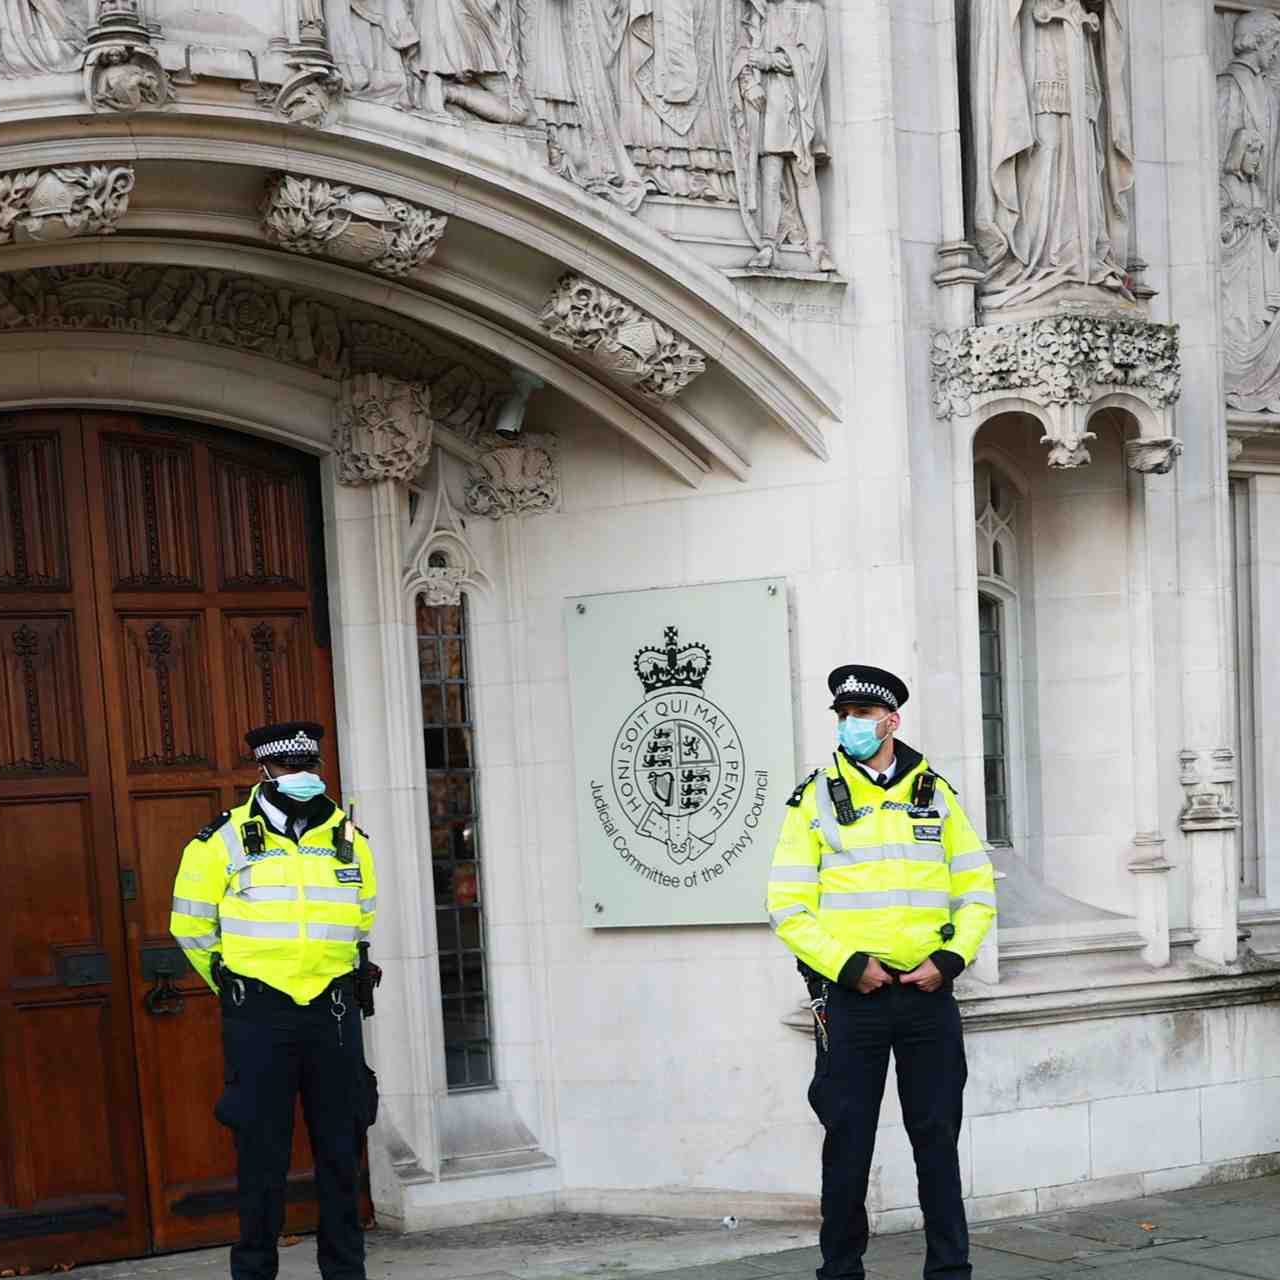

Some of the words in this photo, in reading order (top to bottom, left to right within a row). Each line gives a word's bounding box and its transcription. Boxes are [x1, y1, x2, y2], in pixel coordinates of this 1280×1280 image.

[655, 700, 688, 717] QUI
[694, 704, 725, 738] MAL
[621, 711, 649, 752] SOIT
[723, 739, 737, 751] Y
[618, 759, 641, 813] HONI
[709, 760, 738, 820] PENSE
[590, 780, 618, 838] Judicial
[613, 836, 680, 888] Committee
[684, 872, 697, 888] of
[701, 863, 724, 883] the
[721, 830, 753, 866] Privy
[745, 770, 768, 828] Council
